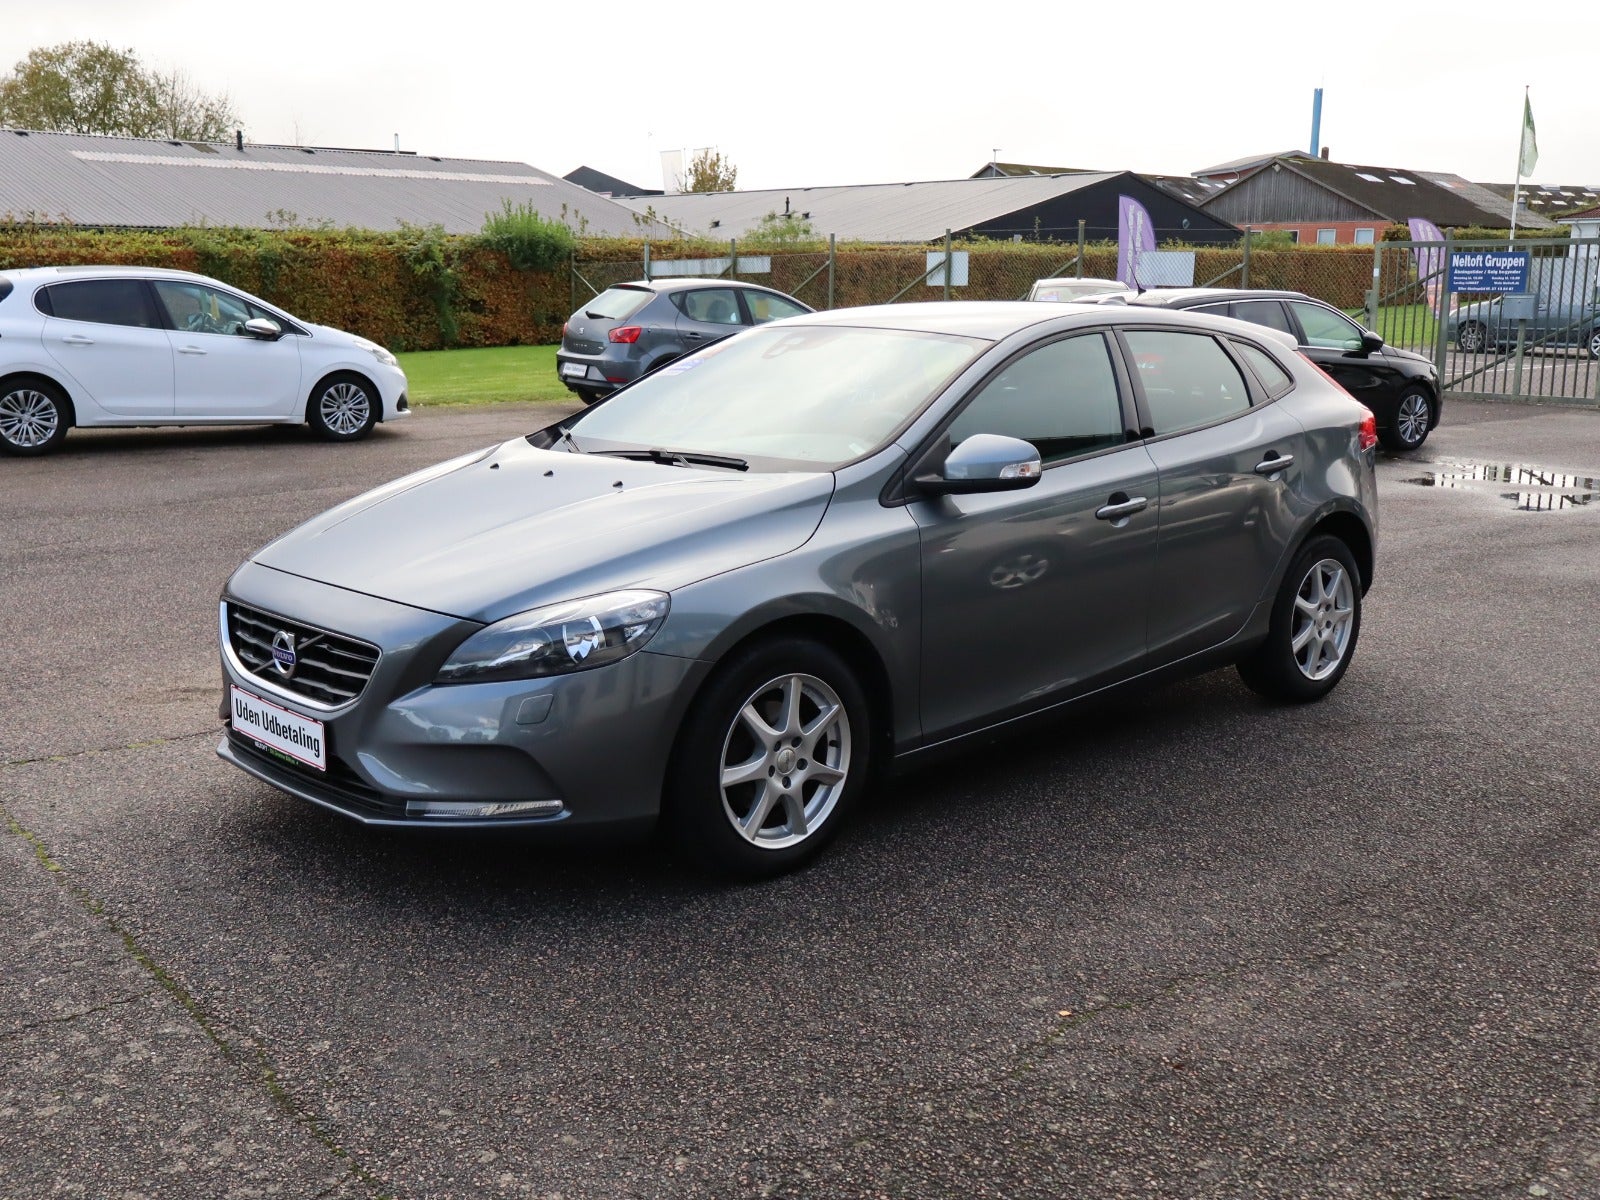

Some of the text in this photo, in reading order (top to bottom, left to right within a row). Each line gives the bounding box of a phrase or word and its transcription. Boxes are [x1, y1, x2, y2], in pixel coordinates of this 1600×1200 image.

[1452, 254, 1525, 269] Neltoft Gruppen
[272, 648, 293, 662] VOLVO
[235, 698, 260, 727] Uden
[262, 710, 320, 759] Udbetaling
